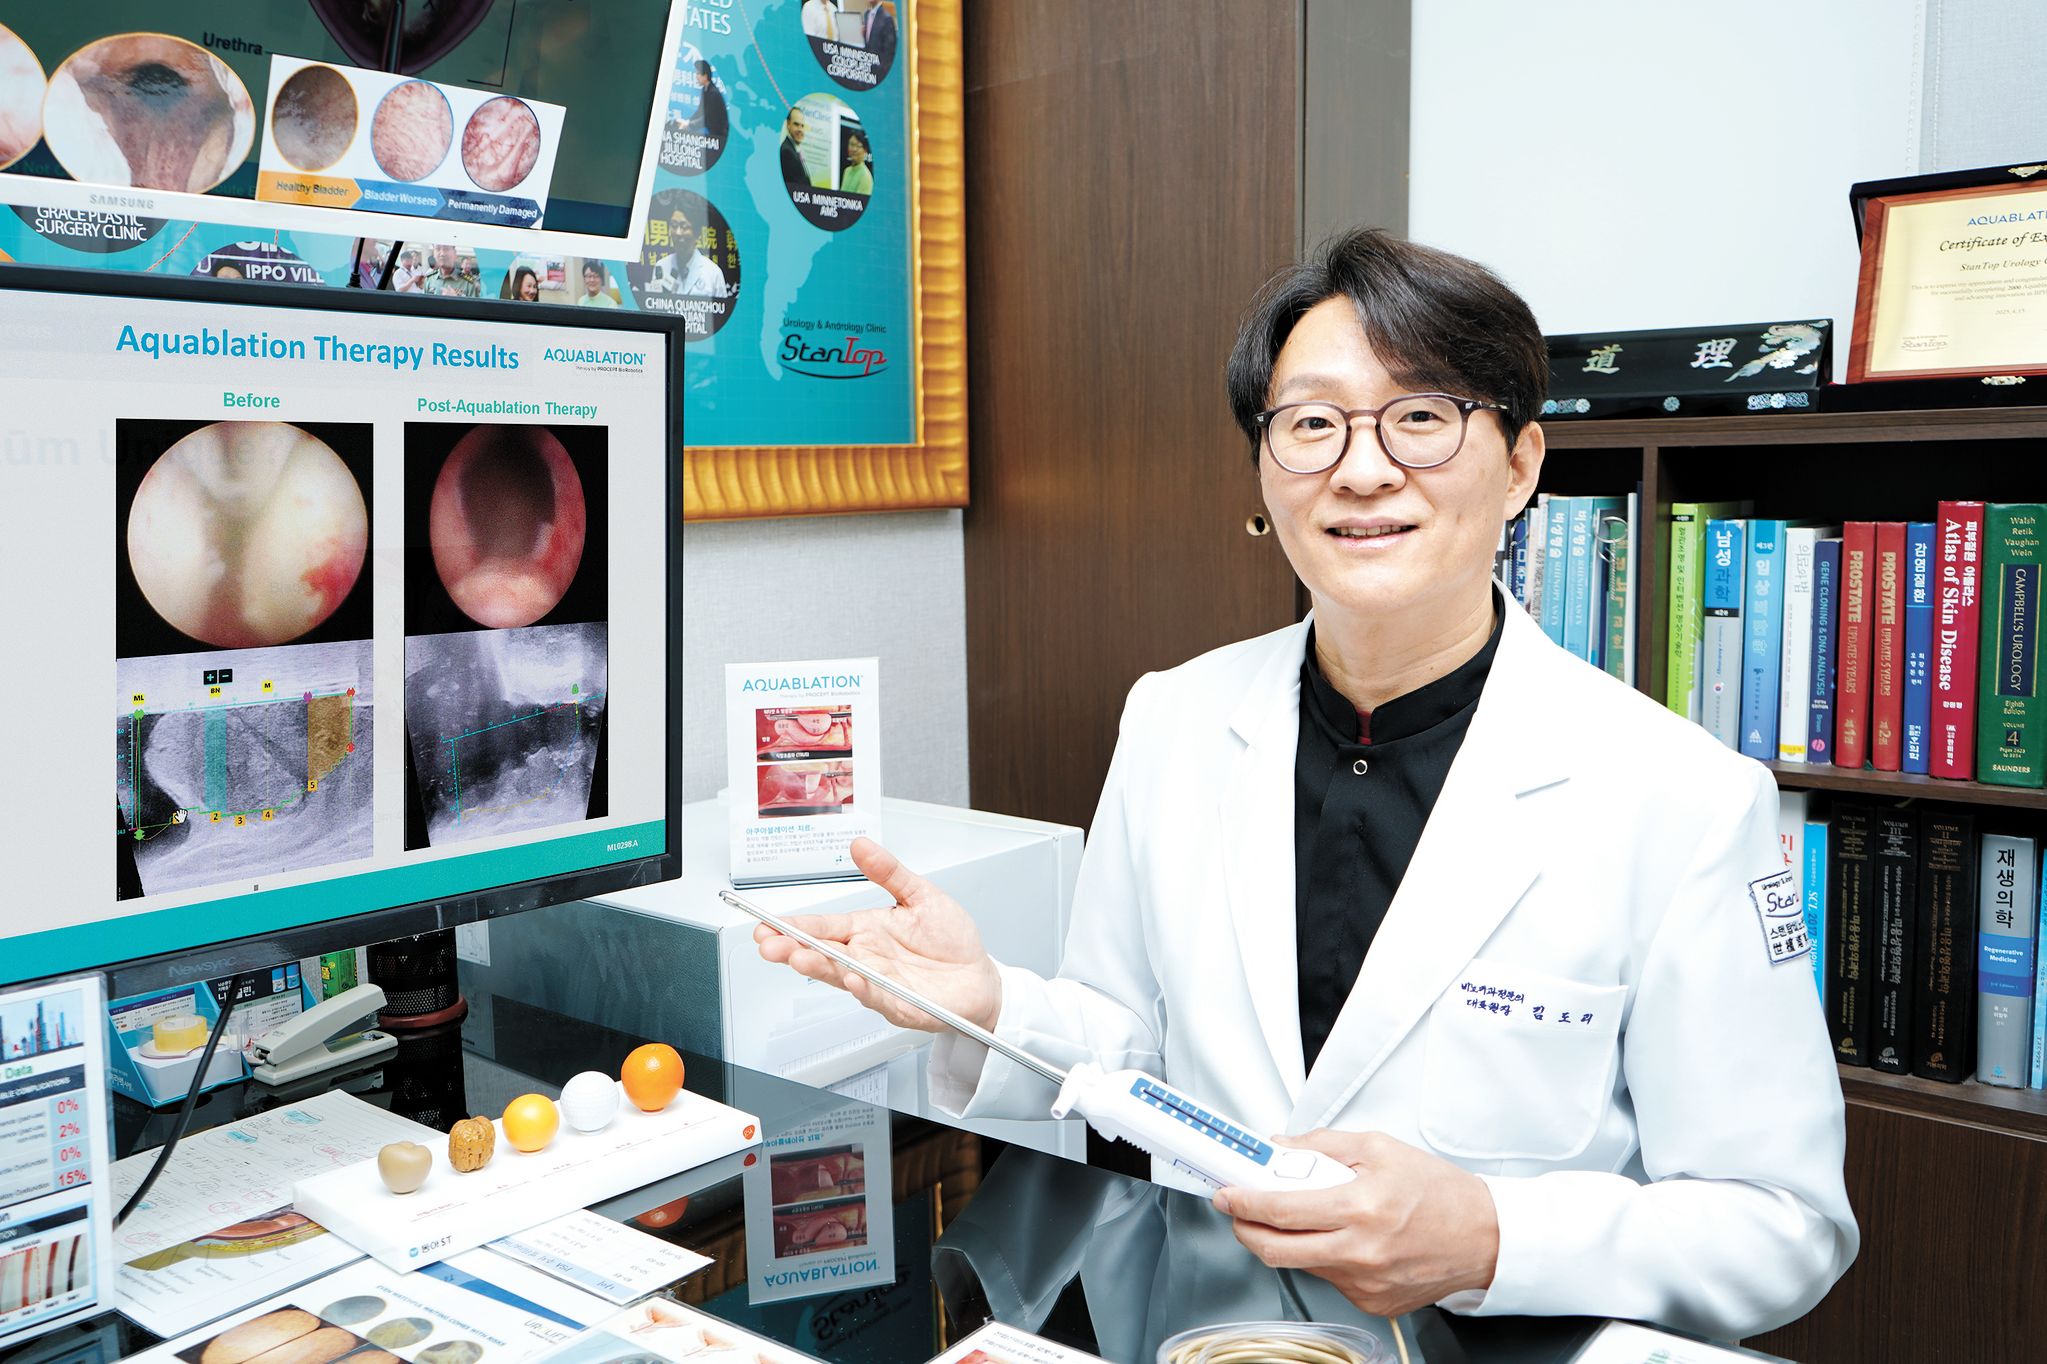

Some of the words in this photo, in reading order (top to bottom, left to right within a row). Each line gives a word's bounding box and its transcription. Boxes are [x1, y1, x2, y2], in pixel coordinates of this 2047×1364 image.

[202, 31, 263, 55] Urethra
[823, 42, 839, 54] USA
[839, 45, 880, 65] MINNESOTA
[673, 132, 719, 150] SHANGHAI
[661, 152, 702, 169] HOSPITAL
[277, 181, 310, 193] Healthy
[313, 185, 348, 196] Bladder
[364, 189, 399, 202] Bladder
[400, 193, 438, 206] Worsens
[90, 194, 154, 209] SAMSUNG
[448, 199, 498, 215] Permanently
[499, 204, 537, 219] Damaged
[793, 192, 811, 204] USA
[812, 193, 863, 211] MINNETONKA
[820, 204, 838, 218] AMS
[37, 207, 86, 222] GRACE
[88, 210, 144, 227] PLASTIC
[35, 219, 101, 237] SURGERY
[102, 224, 148, 242] CLINIC
[1940, 236, 2007, 252] Certificate
[2012, 232, 2029, 247] of
[245, 264, 285, 281] IPPO
[1960, 261, 2000, 272] StanTop
[2003, 258, 2041, 268] Urology
[645, 297, 674, 311] CHINA
[675, 299, 725, 314] QUANZHOU
[783, 318, 815, 332] Urology
[818, 319, 823, 330] &
[825, 320, 864, 334] Andrology
[865, 323, 887, 334] Clinic
[116, 325, 305, 360] Aquablation
[314, 335, 424, 371] Therapy
[432, 341, 519, 370] Results
[544, 347, 645, 366] AQUABLATION
[781, 334, 888, 376] StanTop
[1582, 344, 1623, 374] 道
[1690, 337, 1737, 369] 理
[223, 392, 281, 408] Before
[417, 398, 540, 417] Post-Aquablation
[544, 402, 598, 419] Therapy
[2010, 516, 2036, 525] Walsh
[1944, 518, 1962, 562] Atlas
[1963, 521, 1977, 562] 피부질환
[2012, 528, 2033, 536] Retik
[2004, 538, 2040, 548] Vaughan
[2011, 549, 2033, 557] Wein
[1714, 530, 1733, 602] 남성과학
[1820, 561, 1830, 585] GENE
[1943, 566, 1960, 584] of
[1848, 550, 1863, 623] PROSTATE
[1881, 552, 1896, 625] PROSTATE
[1962, 566, 1976, 607] 아틀라스
[1819, 587, 1829, 626] CLONING
[1941, 587, 1959, 625] Skin
[2013, 568, 2027, 633] CAMPBELL'S
[1818, 635, 1826, 654] DNA
[1847, 626, 1858, 659] UPDATE
[1881, 628, 1892, 661] UPDATE
[1939, 629, 1957, 691] Disease
[2010, 634, 2024, 691] UROLOGY
[743, 675, 860, 692] AQUABLATION
[1816, 655, 1826, 696] ANALYSIS
[1845, 666, 1857, 694] YEARS
[1881, 668, 1891, 696] YEARS
[2005, 700, 2025, 708] Eighth
[1815, 713, 1823, 732] Brown
[2007, 731, 2019, 745] 4
[1992, 764, 2030, 773] SAUNDERS
[1884, 820, 1909, 828] VOLUME
[1890, 827, 1902, 835] III
[1933, 824, 1959, 832] VOLUME
[1996, 848, 2015, 929] 재생의학
[1808, 890, 1818, 910] SCL
[1808, 913, 1818, 936] 2017
[1984, 945, 2024, 957] Regenerative
[1989, 954, 2017, 964] Medicine
[1533, 1005, 1545, 1021] 김
[1558, 1012, 1571, 1023] 도
[5, 1065, 33, 1079] Data
[57, 1098, 79, 1114] 0%
[59, 1122, 80, 1138] 2%
[60, 1146, 81, 1161] 0%
[58, 1168, 87, 1186] 15%
